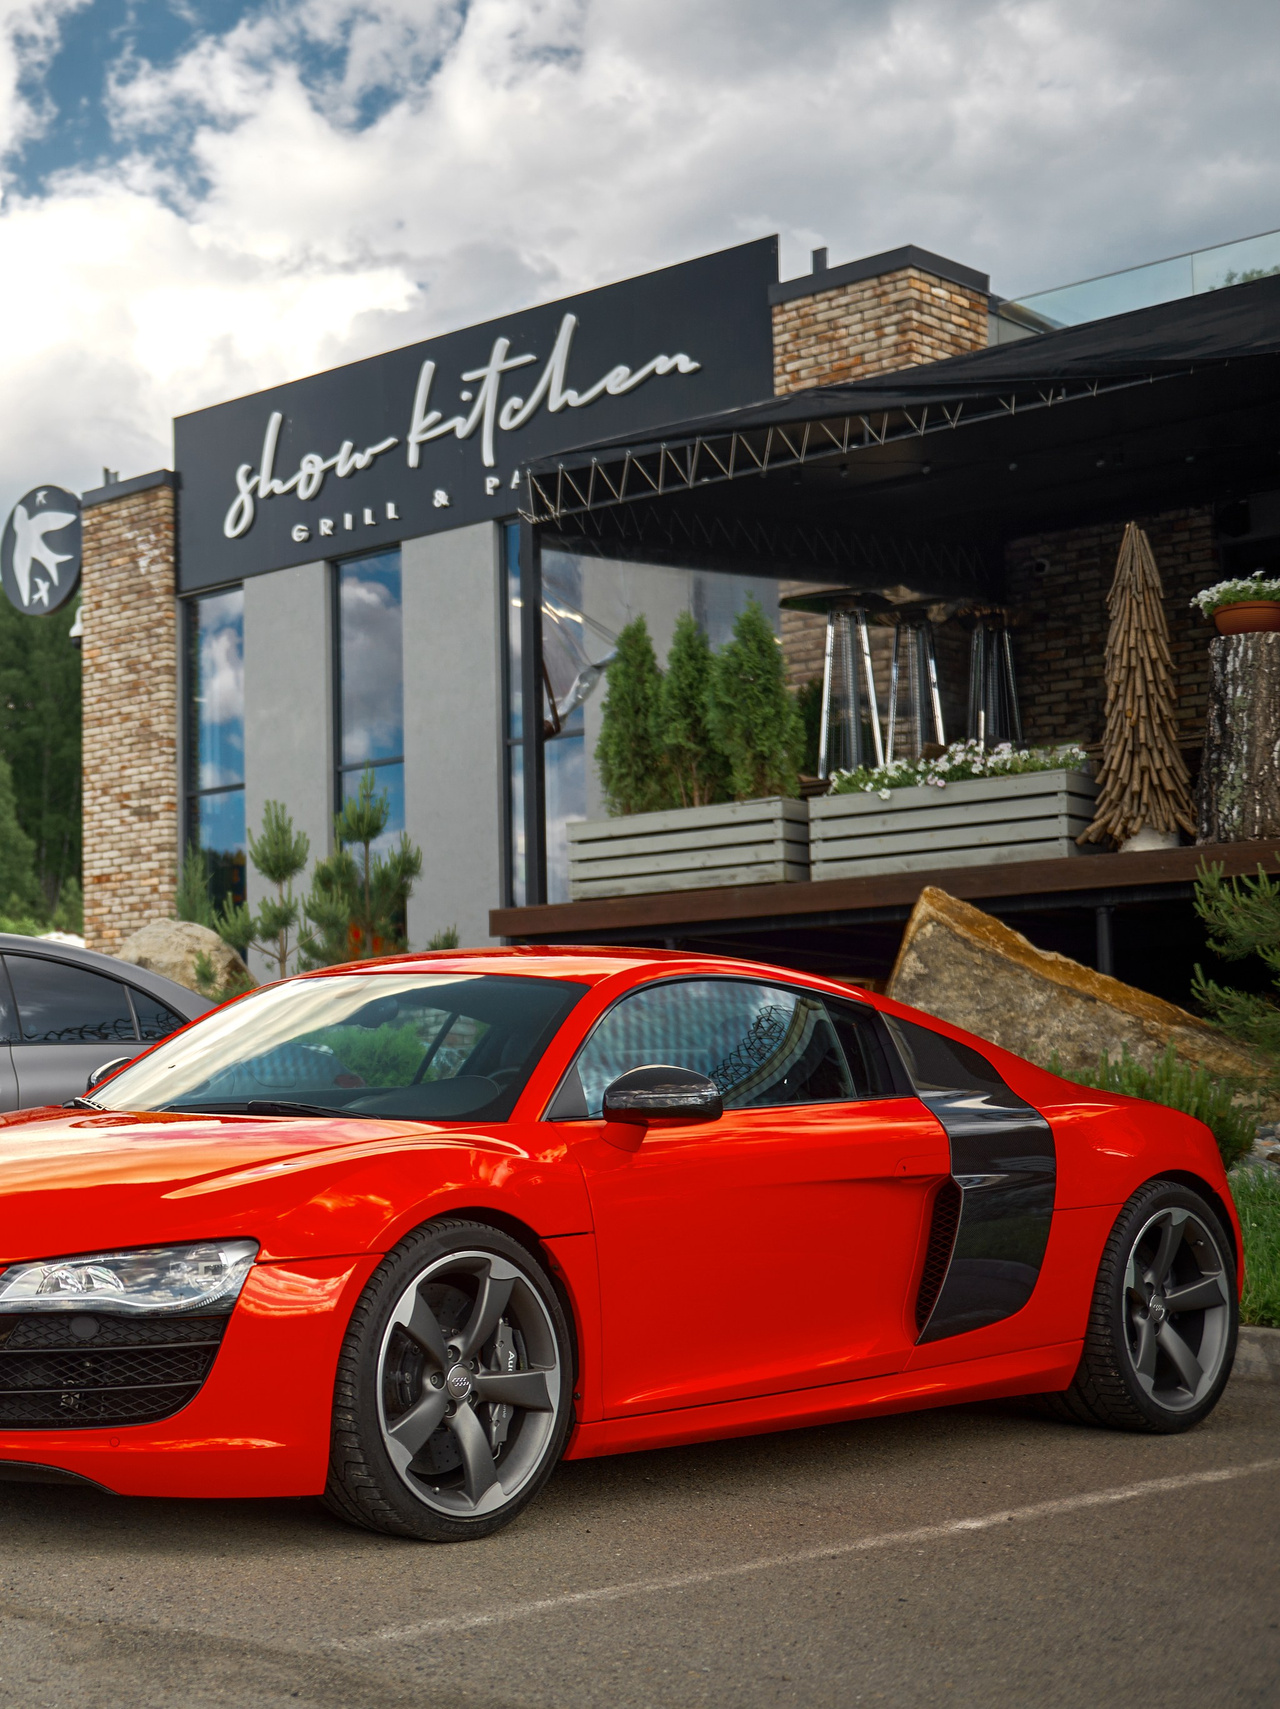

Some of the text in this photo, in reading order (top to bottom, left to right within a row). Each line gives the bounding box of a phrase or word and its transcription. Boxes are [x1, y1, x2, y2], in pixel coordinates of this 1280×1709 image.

[224, 313, 701, 538] show kitchen
[291, 502, 400, 543] GRILL
[433, 489, 450, 508] &
